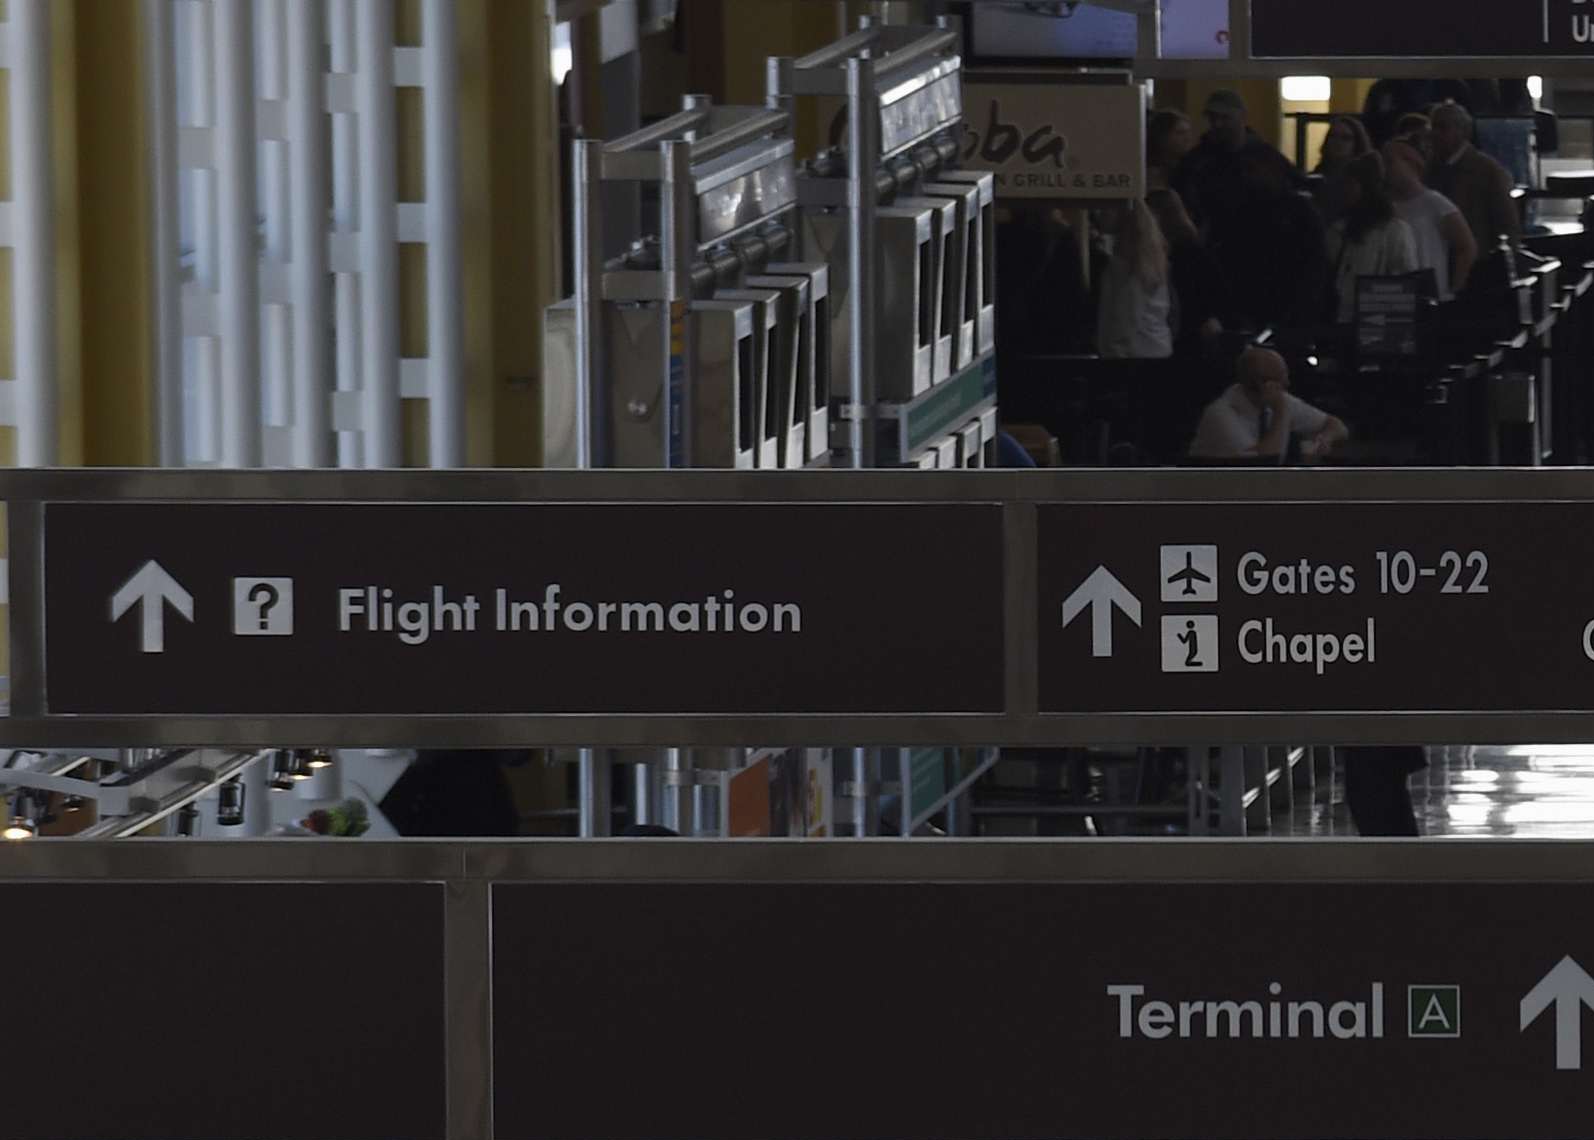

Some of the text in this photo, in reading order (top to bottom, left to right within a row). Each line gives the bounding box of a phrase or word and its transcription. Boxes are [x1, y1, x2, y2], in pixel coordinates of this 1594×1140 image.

[1014, 174, 1066, 188] GRILL
[1073, 174, 1087, 188] &
[1093, 174, 1131, 188] BAR
[1237, 550, 1489, 595] Gates 10-22
[340, 584, 801, 644] Flight Information
[1237, 618, 1375, 675] Chapel
[1107, 982, 1384, 1039] Terminal
